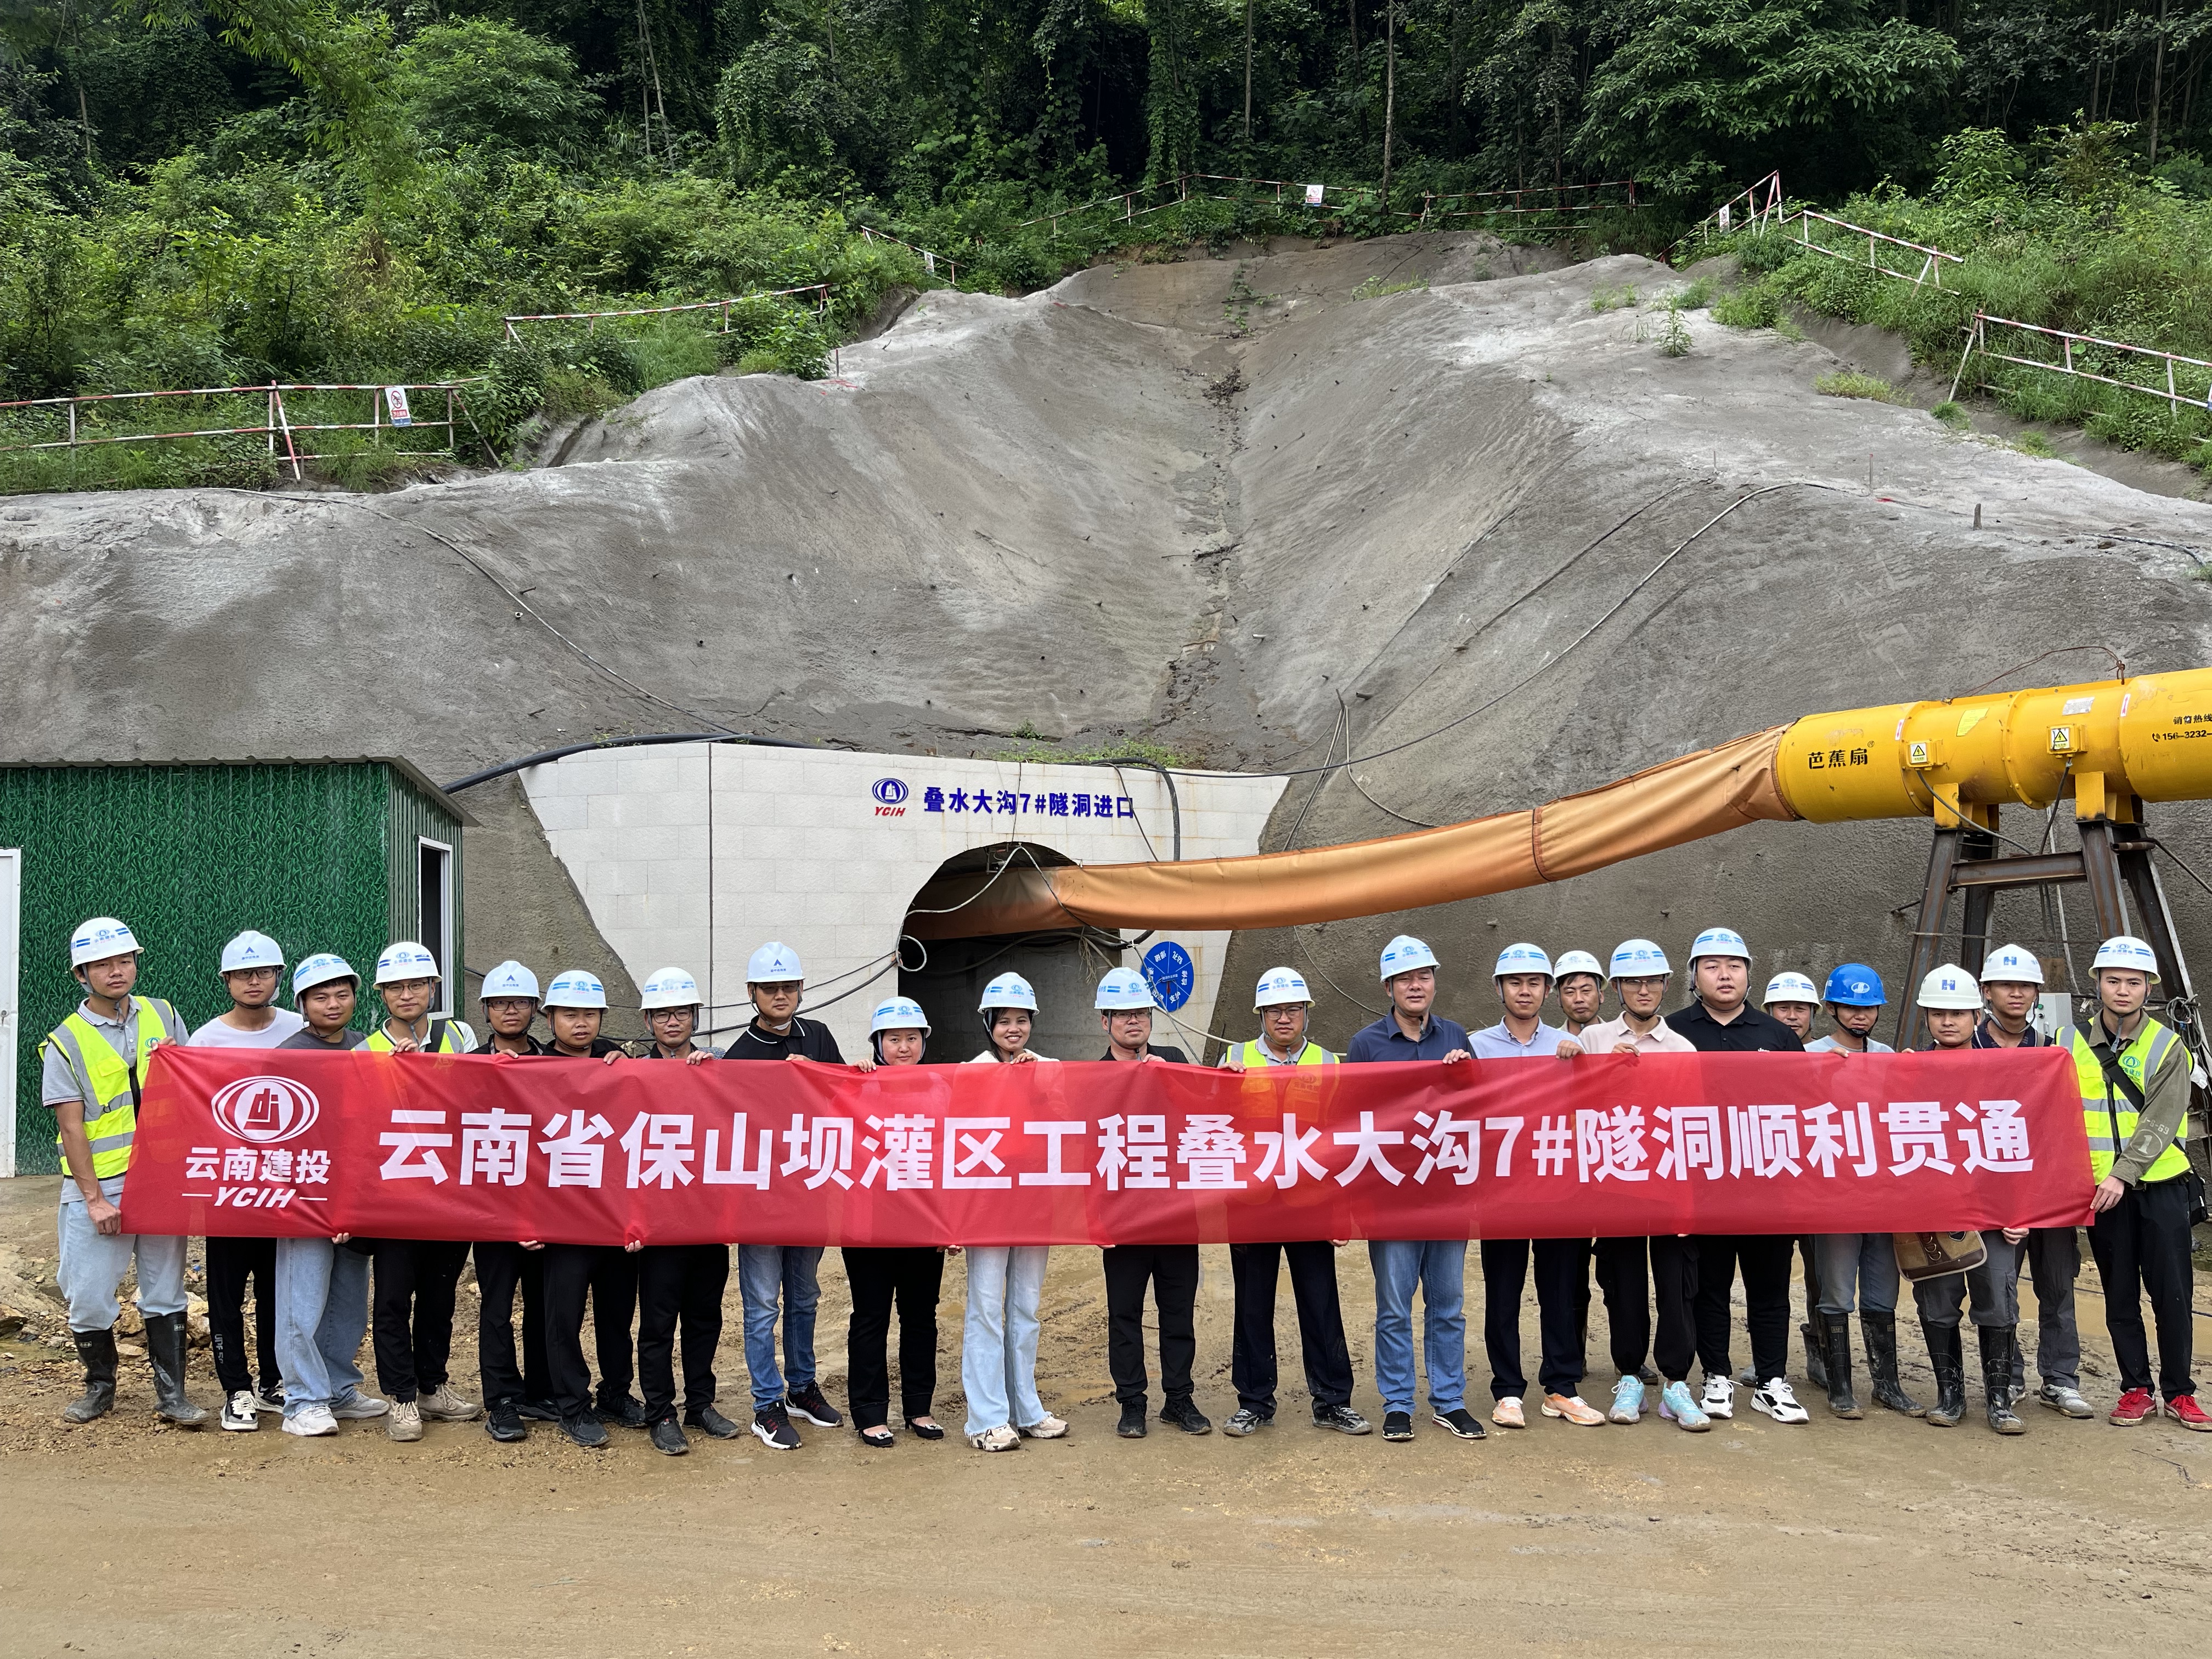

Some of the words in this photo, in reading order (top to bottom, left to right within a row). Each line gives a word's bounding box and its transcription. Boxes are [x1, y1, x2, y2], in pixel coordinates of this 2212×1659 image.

[1808, 748, 1868, 769] 芭蕉扇
[875, 806, 906, 816] YCIH
[924, 787, 1134, 819] 叠水大沟7#隧洞进口
[379, 1099, 2034, 1191] 云南省保山坝灌区工程叠水大沟7#隧洞顺利贯通
[2138, 1135, 2153, 1154] 1
[186, 1147, 331, 1184] 云南建投
[214, 1187, 296, 1208] YCIH
